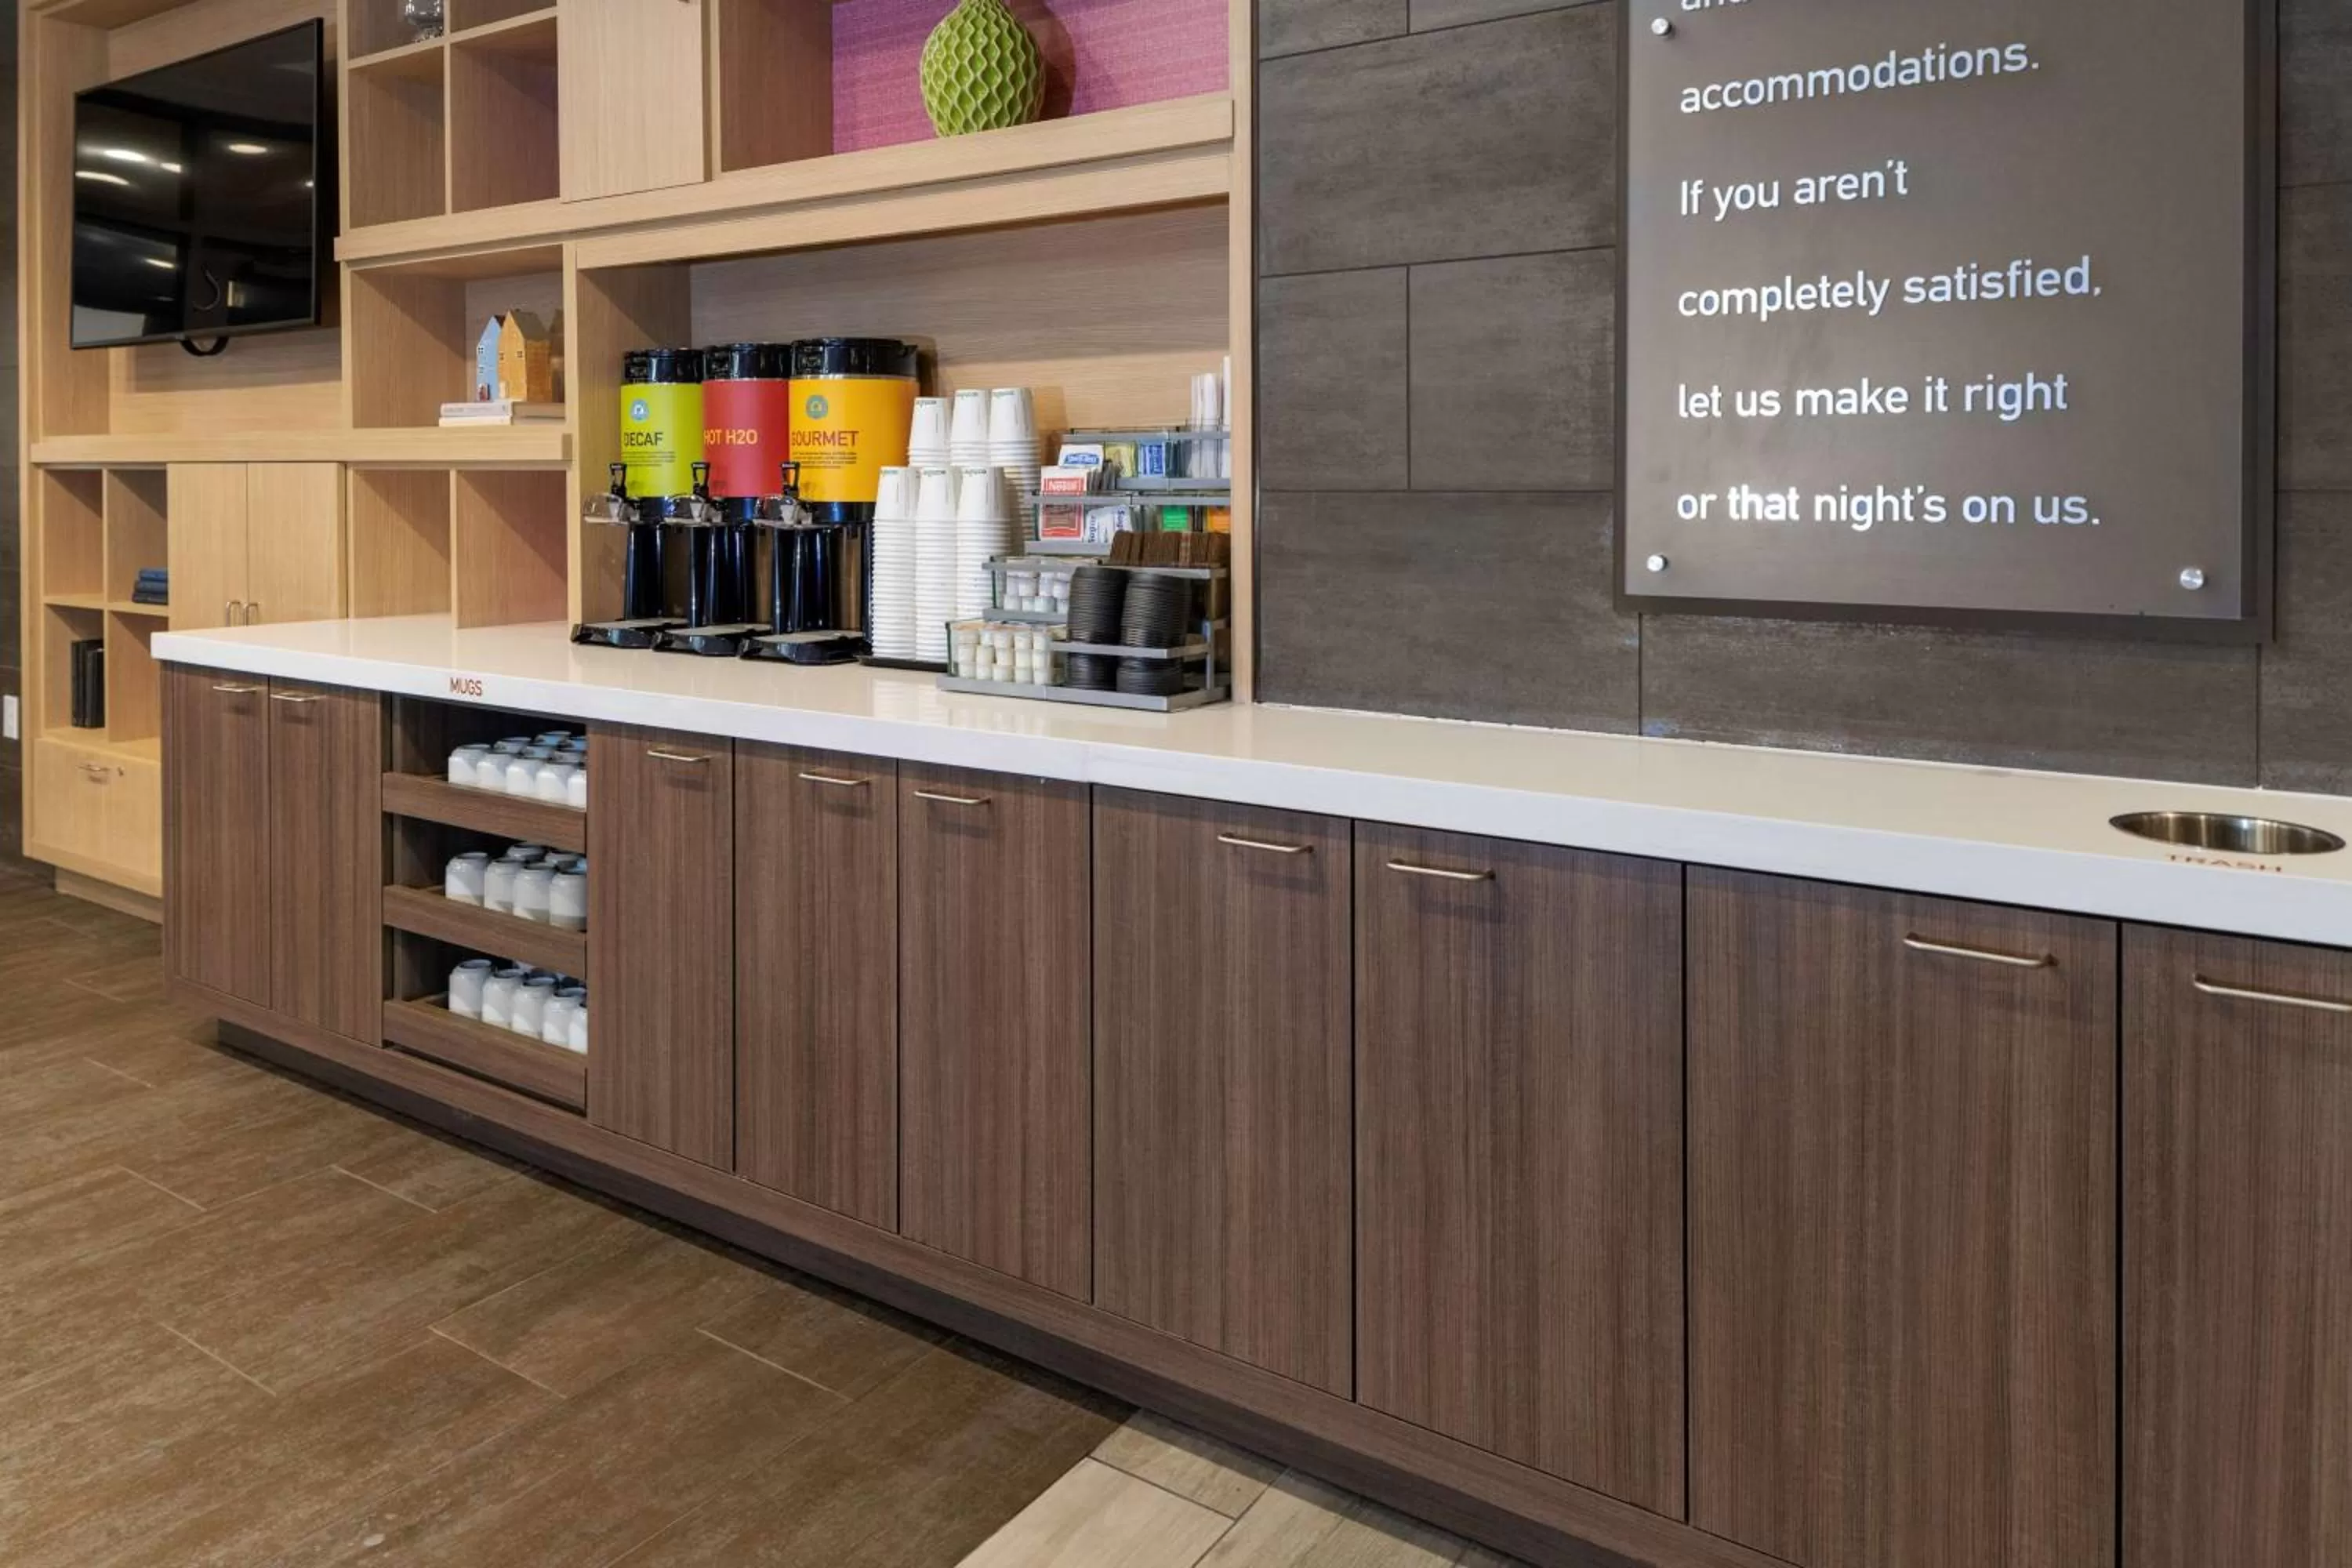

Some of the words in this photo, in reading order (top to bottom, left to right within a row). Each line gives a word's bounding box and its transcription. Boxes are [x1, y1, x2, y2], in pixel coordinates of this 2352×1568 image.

[1680, 42, 2039, 114] accommodations.
[1680, 180, 1704, 216] If
[1713, 180, 1779, 222] you
[1793, 159, 1907, 205] aren't
[1679, 270, 1890, 322] completely
[1903, 255, 2102, 303] satisfied,
[1679, 383, 1722, 418] let
[1736, 390, 1781, 417] us
[1795, 377, 1908, 416] make
[1925, 376, 1948, 412] it
[1965, 372, 2068, 421] right
[623, 432, 664, 447] DECAF
[703, 430, 723, 445] HOT
[725, 430, 758, 445] H2O
[791, 430, 860, 447] GOURMET
[1677, 493, 1718, 520] or
[1727, 484, 1800, 521] that
[1814, 485, 1947, 532] night's
[1962, 495, 2015, 524] on
[2034, 495, 2100, 524] us.
[449, 677, 482, 697] MUGS
